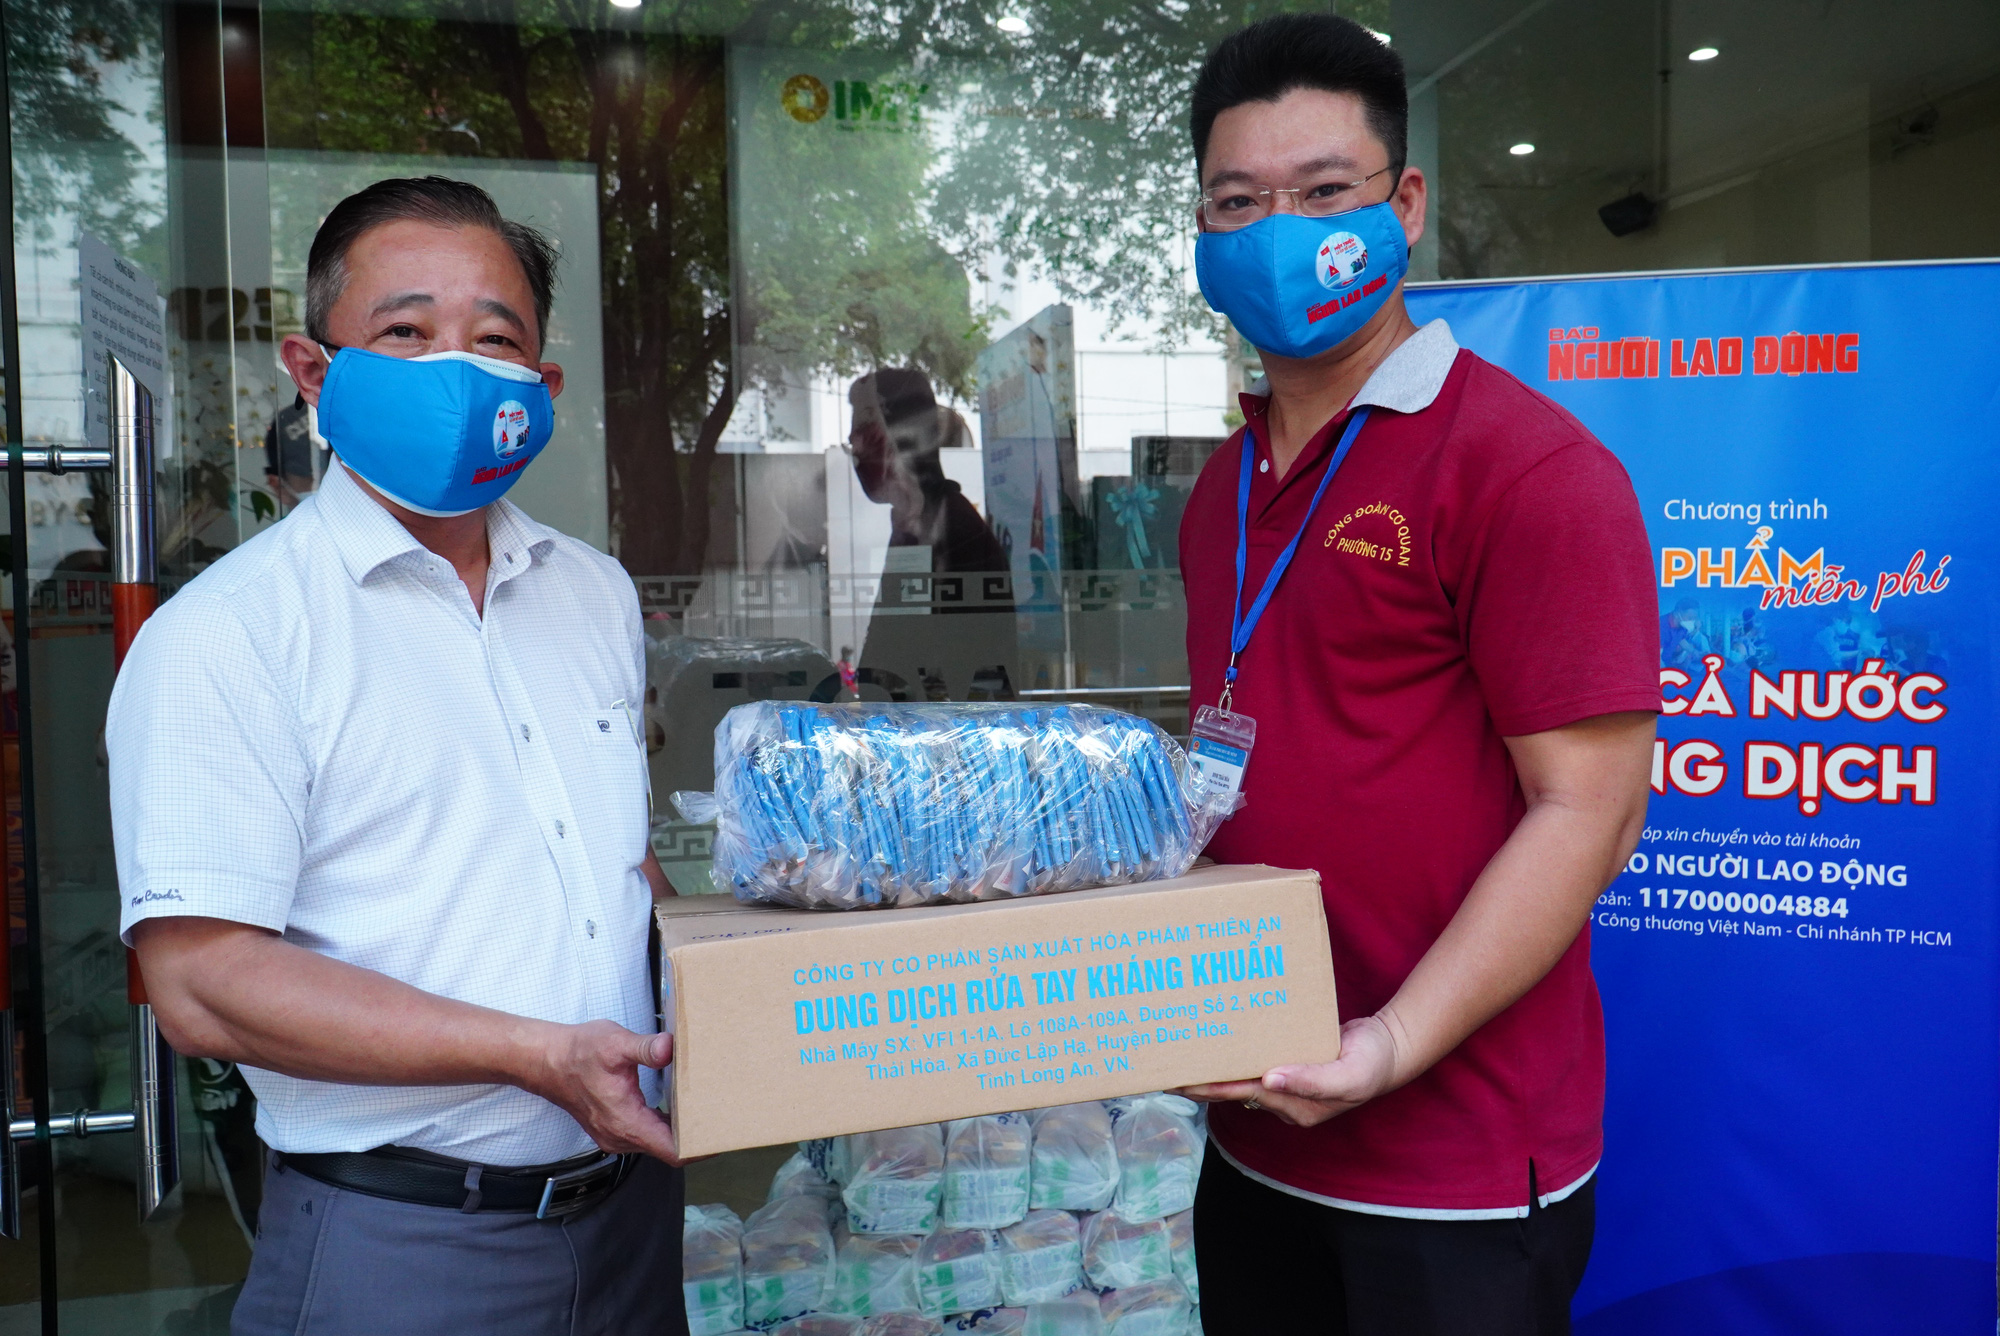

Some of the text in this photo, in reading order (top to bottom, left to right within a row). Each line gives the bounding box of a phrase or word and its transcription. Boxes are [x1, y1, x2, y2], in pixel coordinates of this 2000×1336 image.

[1340, 288, 1361, 308] LAO
[1548, 330, 1859, 381] NGƯỜI LAO ĐỘNG
[1549, 326, 1599, 341] BÁO
[1324, 500, 1411, 566] CÔNG ĐOÀN CƠ QUAN
[1663, 497, 1828, 525] Chương trình
[1337, 538, 1394, 561] PHƯỜNG 15
[1661, 526, 1824, 588] PHẨM
[1759, 549, 1952, 613] miễn phí
[1660, 653, 1947, 723] CẢ NƯỚC
[1744, 740, 1937, 817] DỊCH
[1642, 826, 1860, 849] óp xin chuyển vào tài khoản
[1622, 852, 1908, 890] O NGƯỜI LAO ĐỘNG
[1596, 888, 1849, 918] oản: 117000004884
[794, 962, 854, 986] CÔNG
[860, 960, 886, 978] TY
[1196, 917, 1251, 939] THIÊN
[1256, 916, 1282, 933] AN
[1598, 914, 1640, 932] Công
[1645, 915, 1704, 936] thương
[1708, 919, 1739, 936] Việt
[1744, 920, 1782, 936] Nam
[1796, 924, 1823, 939] Chi
[1828, 926, 1881, 942] nhánh
[1886, 928, 1906, 943] TP
[1911, 931, 1952, 946] HCM
[794, 933, 1285, 1035] DUNG DỊCH RỬA TAY KHÁNG KHUẨN
[800, 1045, 836, 1064] Nhà
[842, 1040, 878, 1060] Máy
[885, 1036, 916, 1054] SX:
[922, 1030, 954, 1048] VFI
[1010, 1020, 1032, 1038] Lô
[1037, 1009, 1134, 1034] 108A-109A,
[1139, 1003, 1198, 1022] Đường
[1203, 993, 1226, 1014] Số
[1230, 995, 1244, 1012] 2,
[1249, 989, 1288, 1008] KCN
[866, 1020, 1234, 1080] Thái Hòa, Xã Đức Lập Hạ, Huyện Đức Hòa,
[1021, 1066, 1065, 1084] Long
[1070, 1061, 1099, 1078] An,
[1104, 1055, 1135, 1072] VN.
